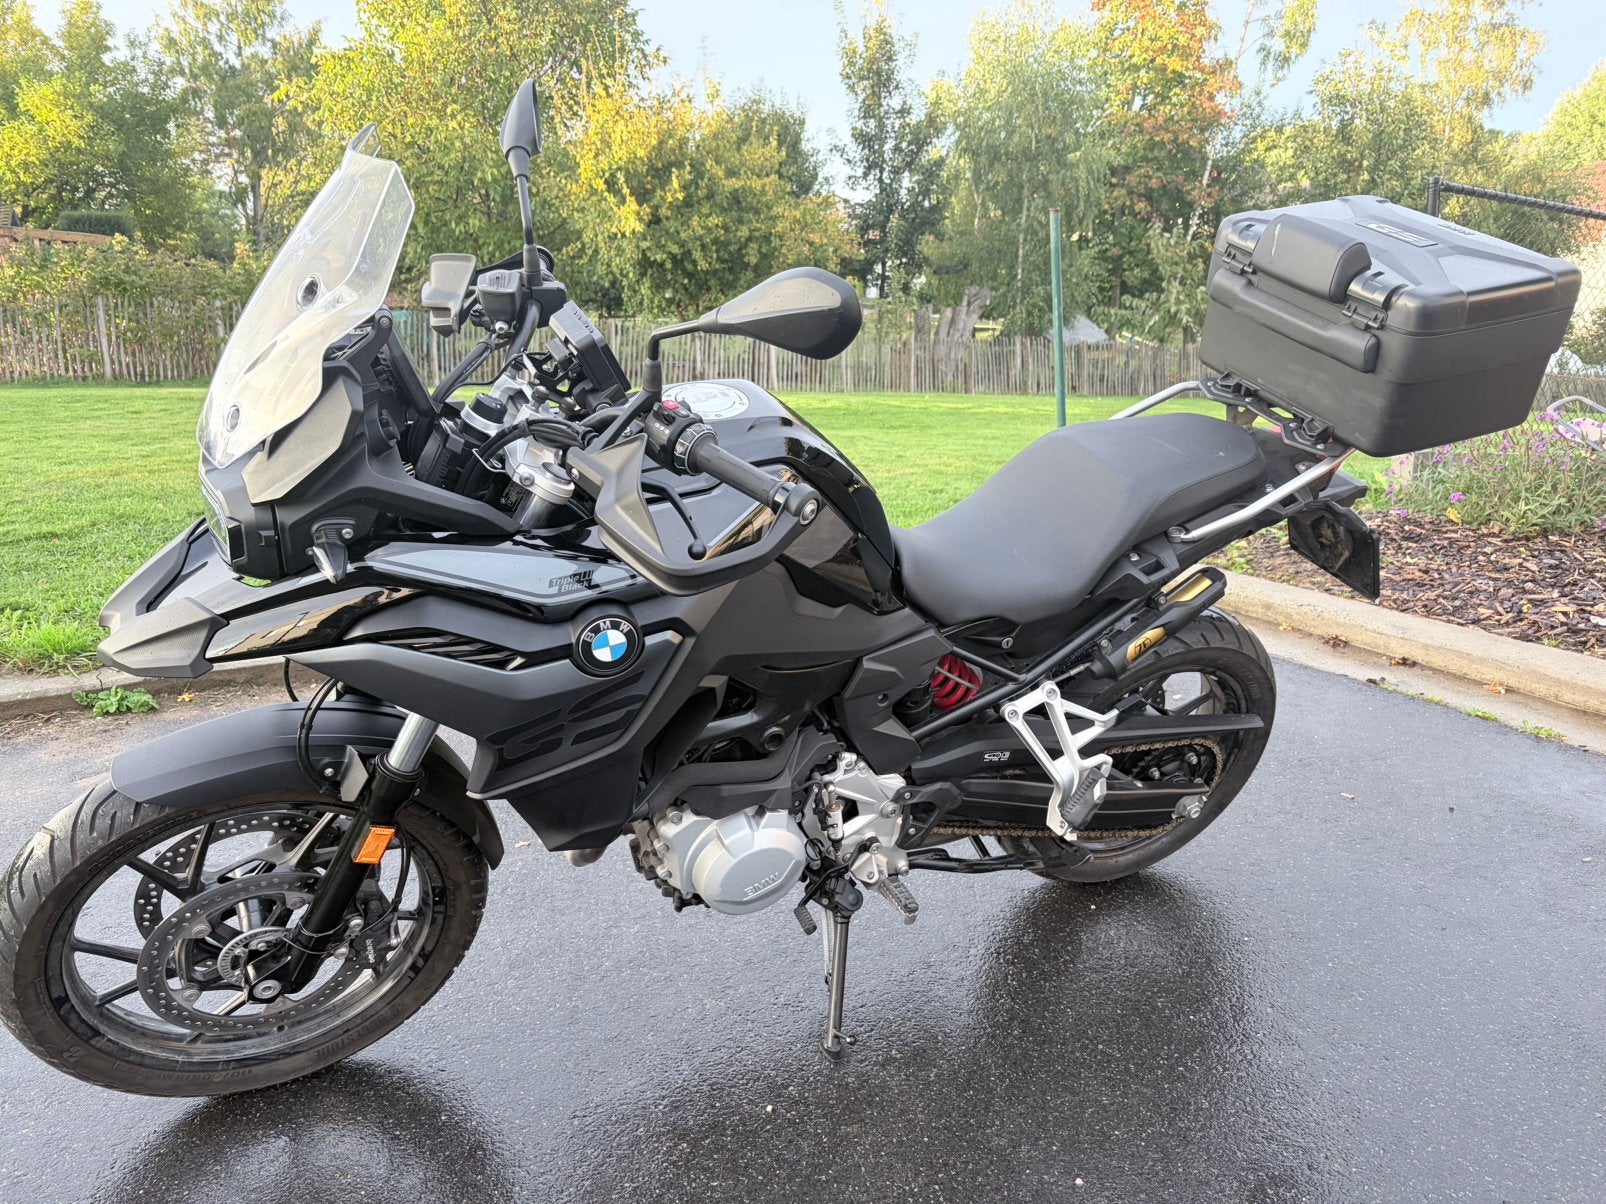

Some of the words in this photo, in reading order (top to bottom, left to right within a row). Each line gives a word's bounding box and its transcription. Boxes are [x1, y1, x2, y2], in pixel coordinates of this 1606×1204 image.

[551, 573, 580, 587] Triple
[561, 580, 589, 593] Black
[583, 620, 631, 643] BMW
[743, 871, 779, 896] BMW
